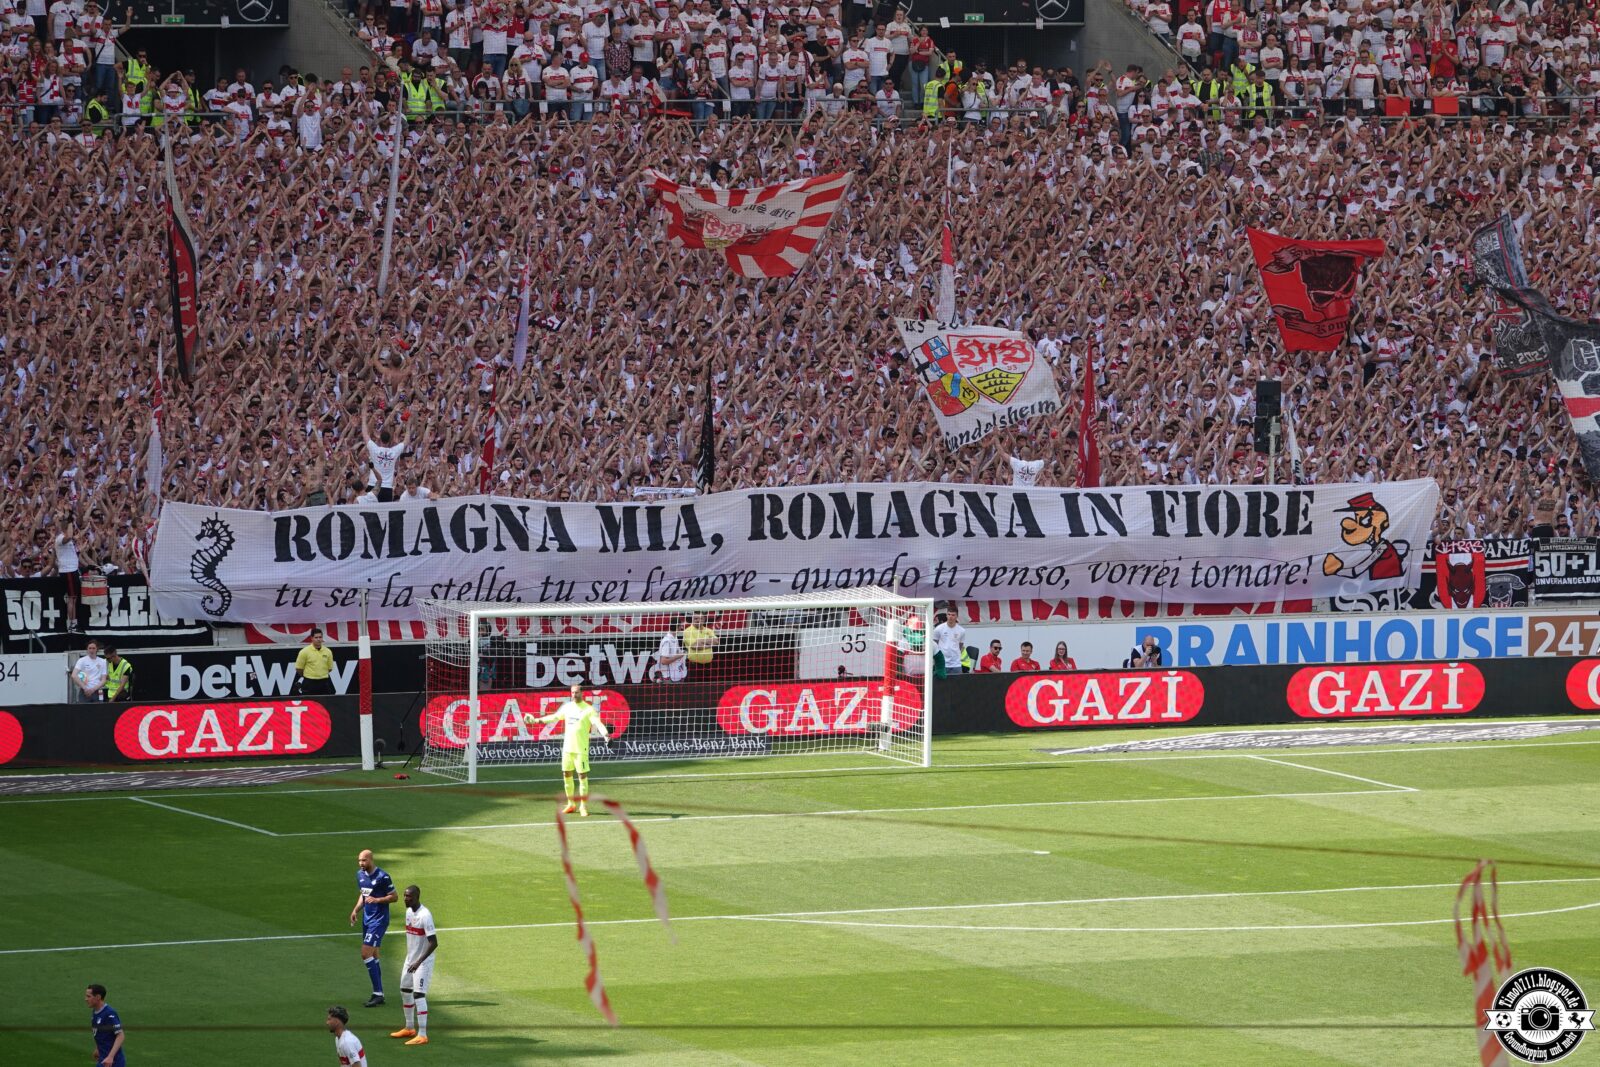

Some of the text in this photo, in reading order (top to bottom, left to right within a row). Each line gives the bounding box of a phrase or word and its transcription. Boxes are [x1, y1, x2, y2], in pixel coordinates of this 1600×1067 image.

[273, 489, 1315, 562] ROMAGNA MIA, ROMAGNA IN FIORE
[274, 583, 313, 608] tu
[380, 572, 413, 608] la
[540, 575, 576, 602] tu
[585, 568, 633, 602] sei
[641, 565, 757, 602] l'amore
[791, 552, 921, 594] quando
[933, 554, 962, 589] ti
[962, 563, 1071, 598] penso,
[1087, 555, 1183, 589] vorrei
[1190, 555, 1313, 589] tornare!
[1535, 551, 1600, 578] 50+1
[841, 633, 867, 654] 35
[1135, 616, 1600, 668] BRAINHOUSE 247
[170, 654, 358, 700] betwy
